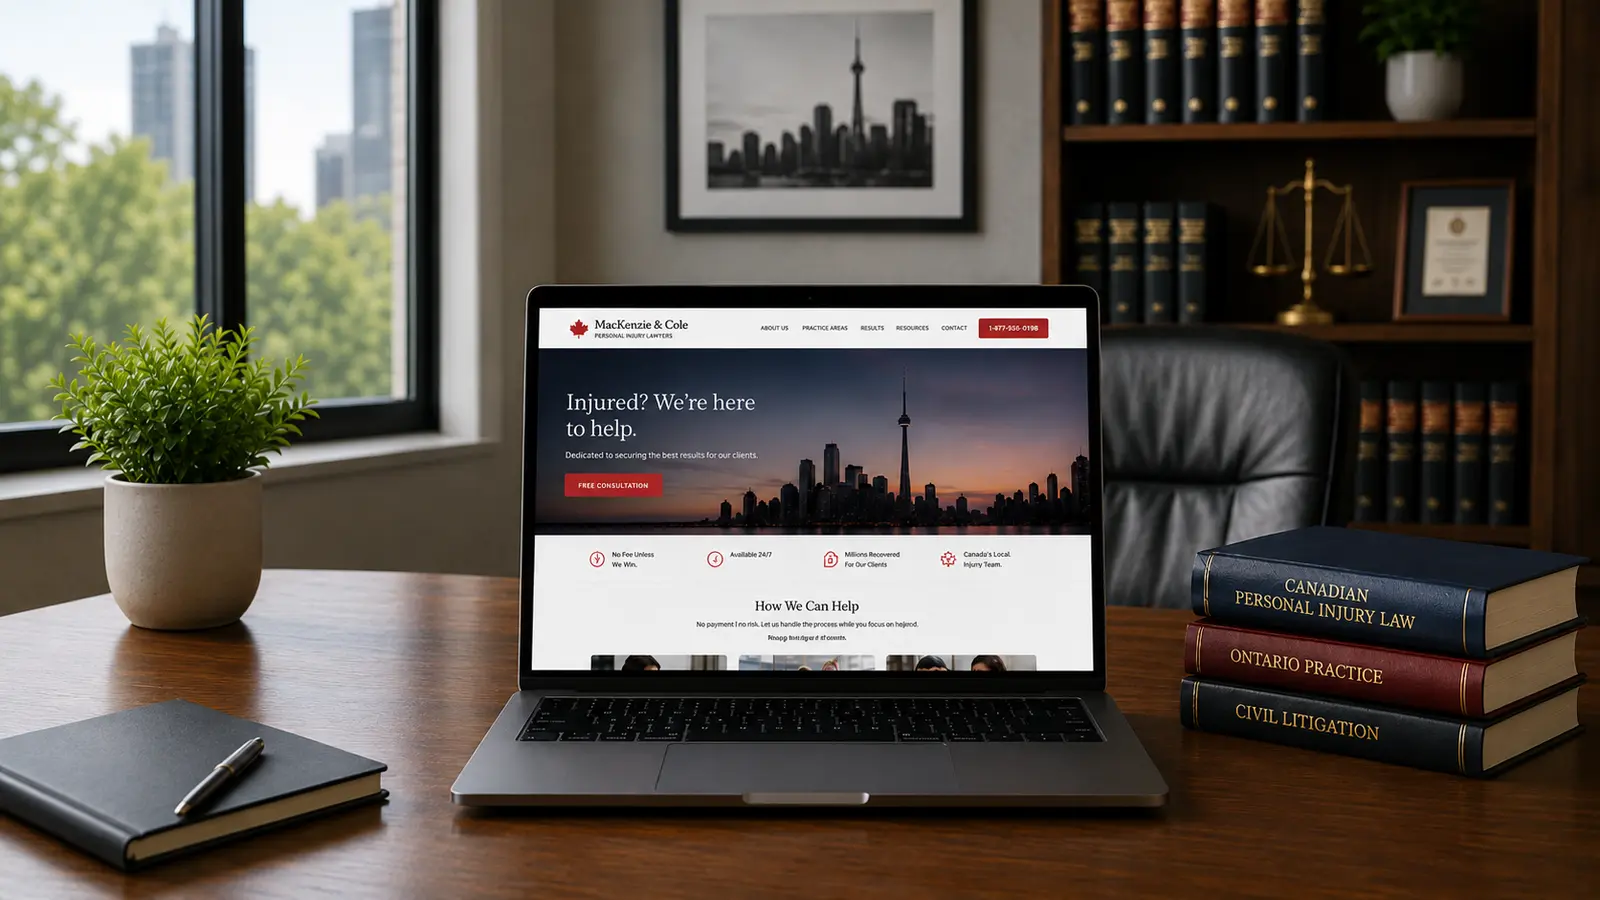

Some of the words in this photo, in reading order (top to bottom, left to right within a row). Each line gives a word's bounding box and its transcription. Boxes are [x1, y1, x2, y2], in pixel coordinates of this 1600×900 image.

[594, 319, 652, 330] MacKenzie
[653, 319, 663, 330] &
[664, 319, 689, 330] Cole
[566, 392, 649, 416] Injured?
[653, 392, 708, 411] We’re
[712, 392, 756, 411] here
[566, 422, 586, 438] to
[590, 419, 637, 442] help.
[565, 451, 604, 459] Dedicated
[614, 451, 647, 461] securing
[648, 451, 661, 459] the
[661, 451, 678, 459] best
[679, 451, 705, 459] results
[706, 451, 717, 459] for
[732, 451, 759, 459] clients.
[1284, 577, 1369, 604] CANADIAN
[754, 600, 782, 612] How
[785, 600, 803, 612] We
[805, 600, 829, 612] Can
[831, 600, 860, 614] Help
[1234, 590, 1314, 616] PERSONAL
[1318, 602, 1376, 626] INJURY
[1379, 611, 1416, 631] LAW
[706, 621, 734, 629] payment
[1229, 647, 1301, 673] ONTARIO
[1304, 659, 1384, 686] PRACTICE
[1235, 703, 1279, 726] CIVIL
[1282, 711, 1380, 742] LITIGATION
